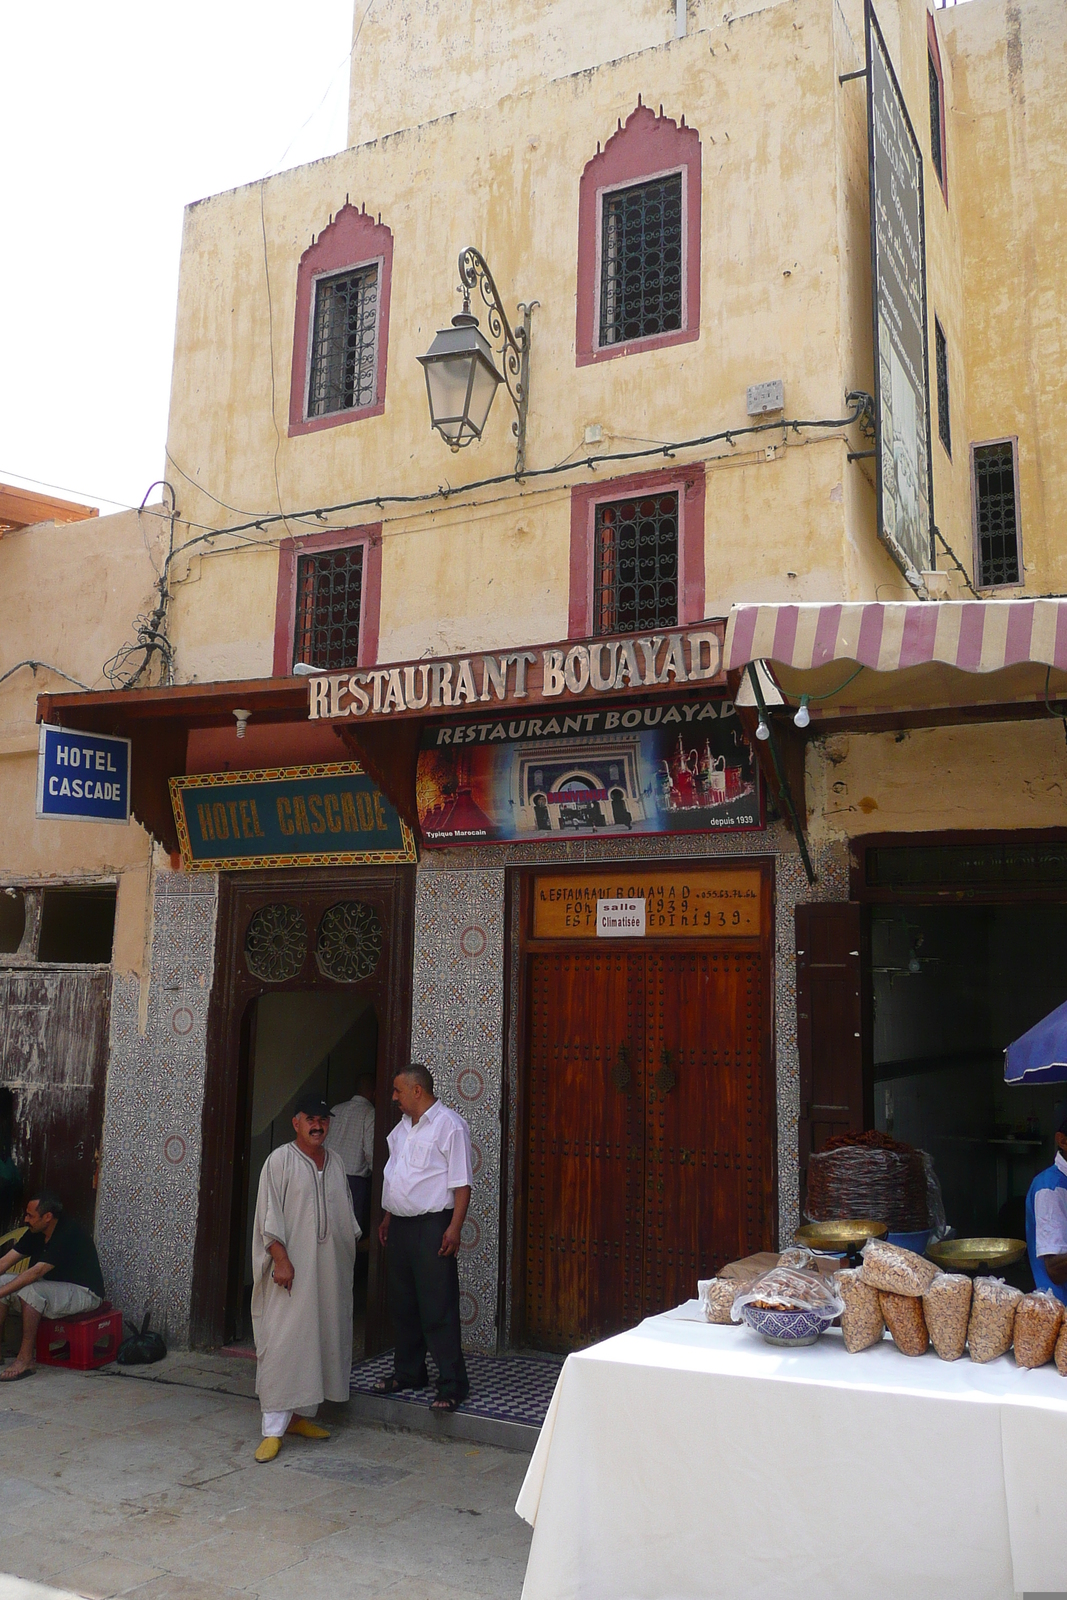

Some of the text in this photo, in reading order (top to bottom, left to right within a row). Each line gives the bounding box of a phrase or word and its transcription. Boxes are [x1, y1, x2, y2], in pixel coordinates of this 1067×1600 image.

[874, 103, 905, 190] WELCOME
[308, 631, 721, 720] RESTAURANT BOUAYAD
[436, 700, 736, 745] RESTAURANT BOUAYAD
[56, 745, 117, 772] HOTEL
[49, 776, 121, 801] CASCADE
[547, 789, 608, 803] BIENVENUE
[197, 790, 388, 841] HOTEL CASCADE
[710, 815, 753, 827] depuis 1939
[454, 829, 487, 837] Marocain
[603, 903, 637, 911] salle
[602, 916, 640, 927] Climatisée
